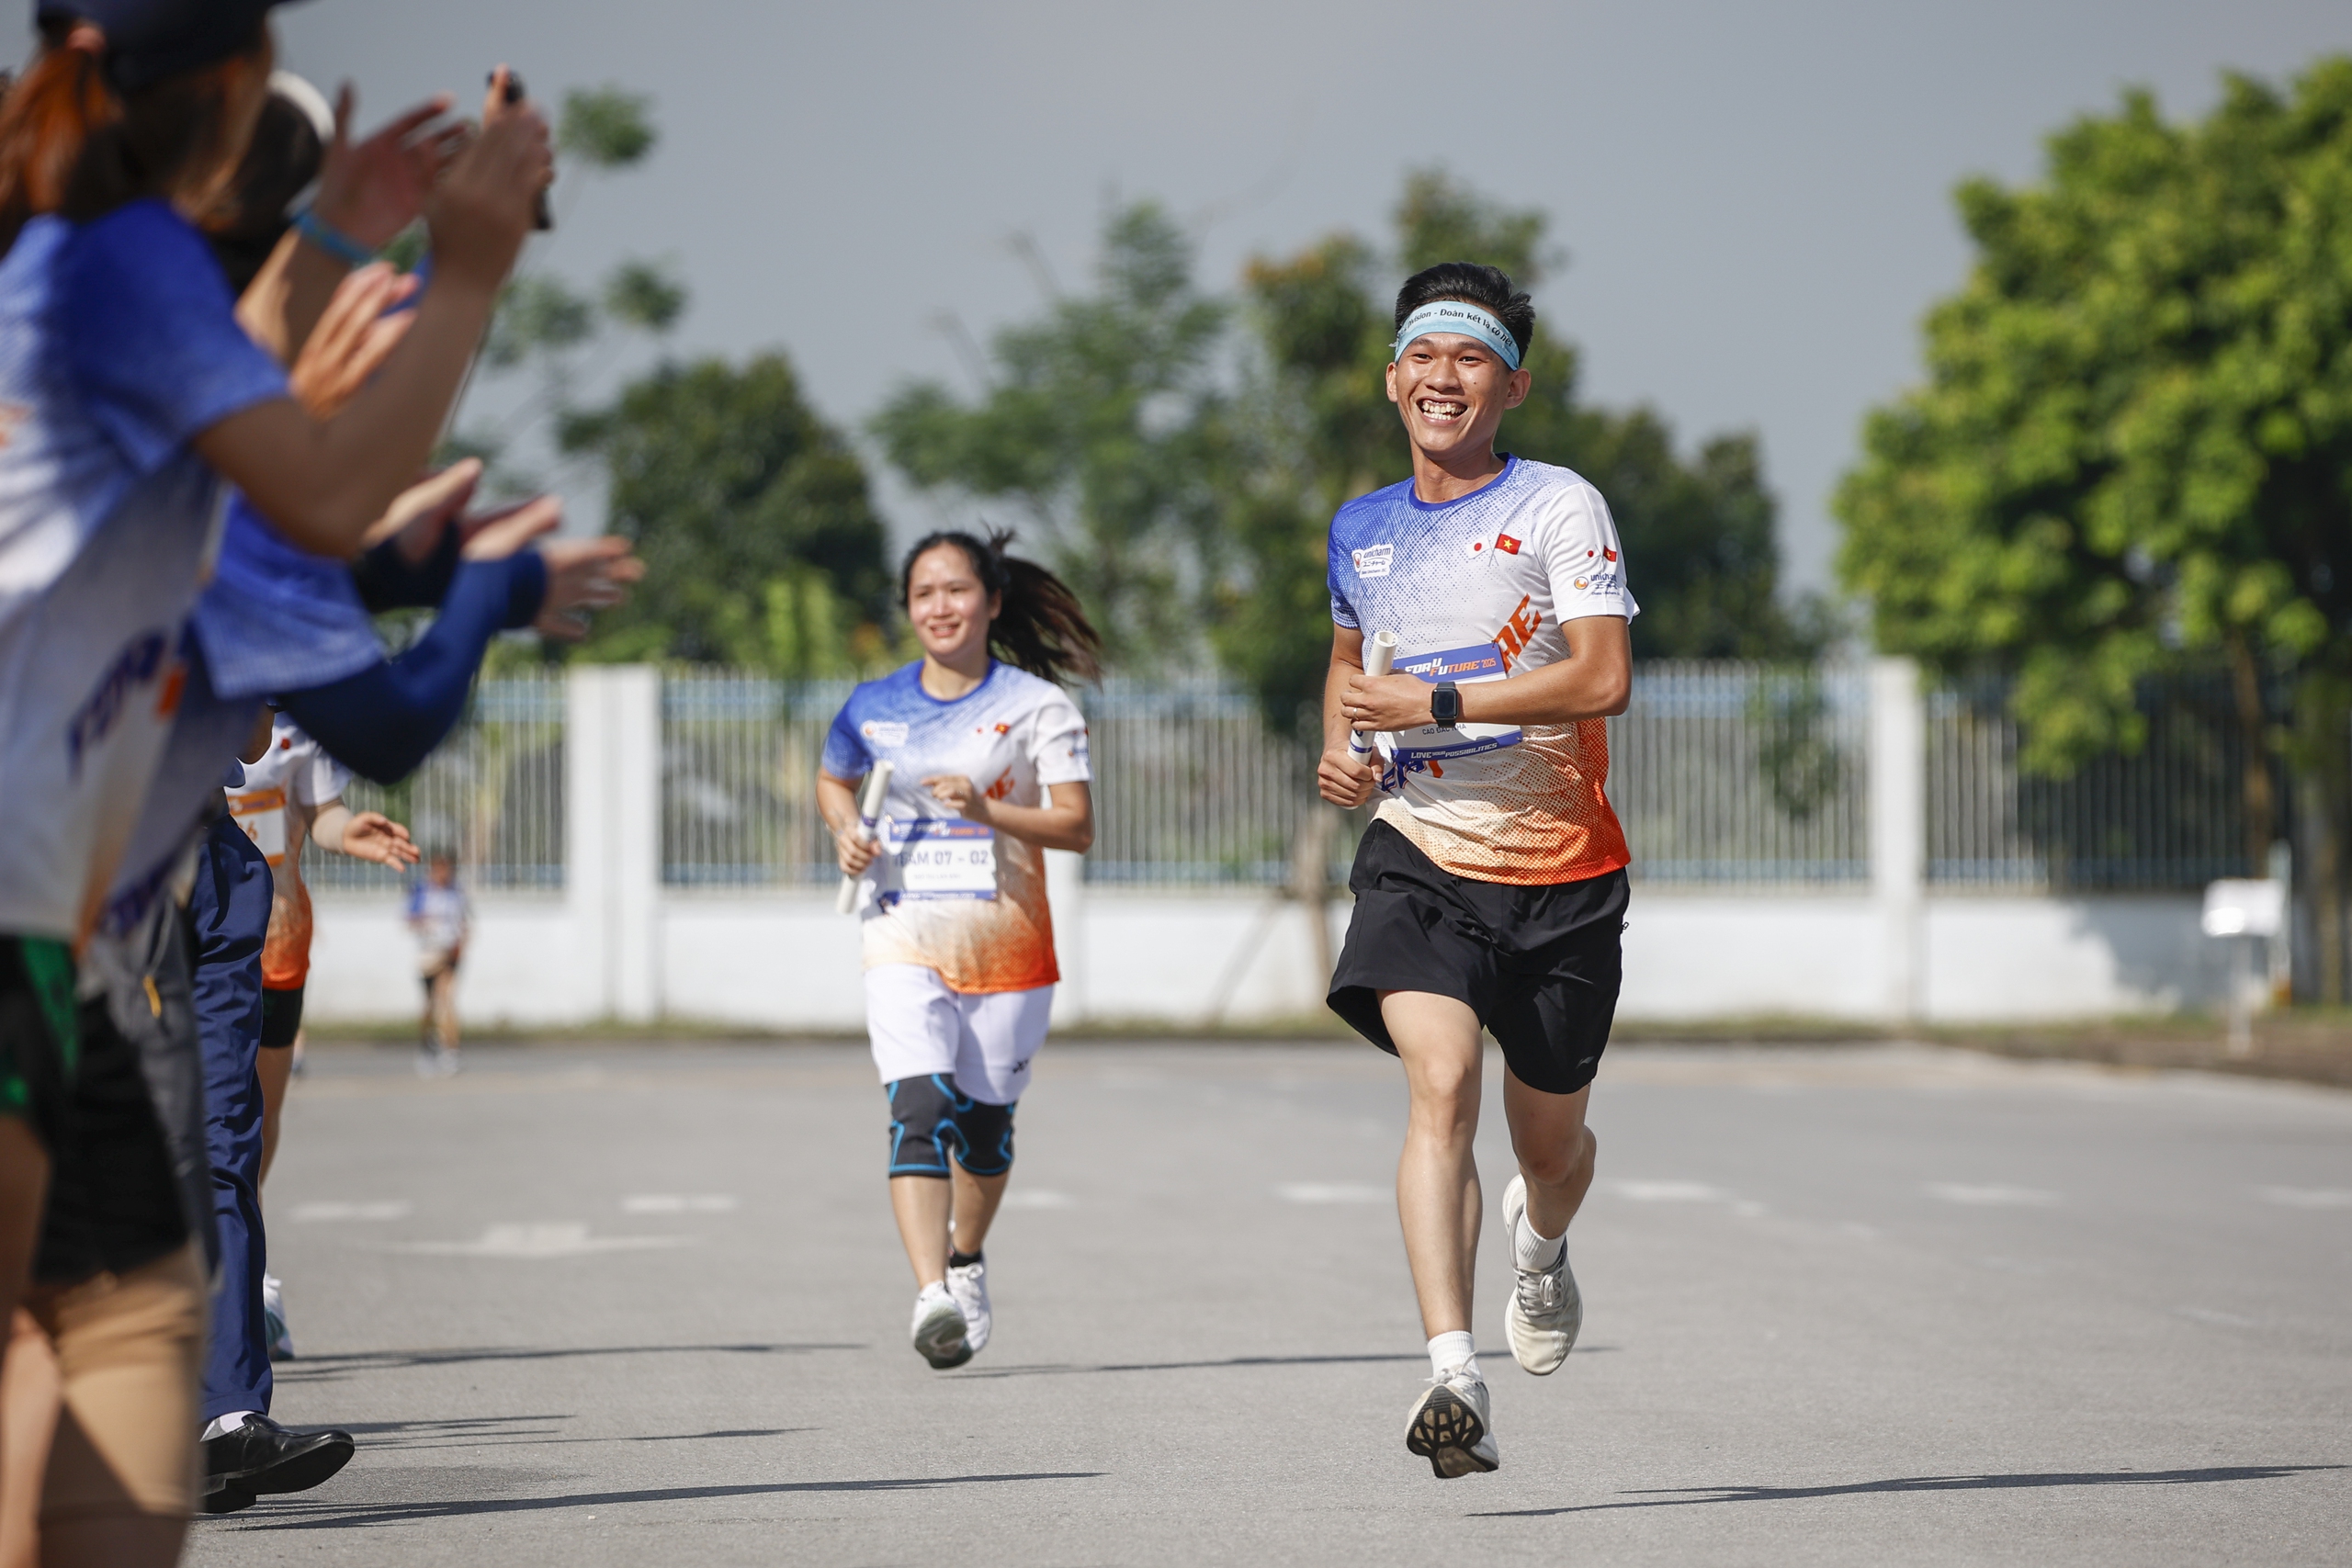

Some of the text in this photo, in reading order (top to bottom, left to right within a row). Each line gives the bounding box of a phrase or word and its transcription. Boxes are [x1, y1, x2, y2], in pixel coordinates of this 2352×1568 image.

[1363, 547, 1391, 558] unicharm
[1481, 658, 1497, 668] 2025
[1445, 742, 1498, 758] POSSIBILITIES
[934, 851, 953, 865] 07
[970, 850, 989, 865] 02
